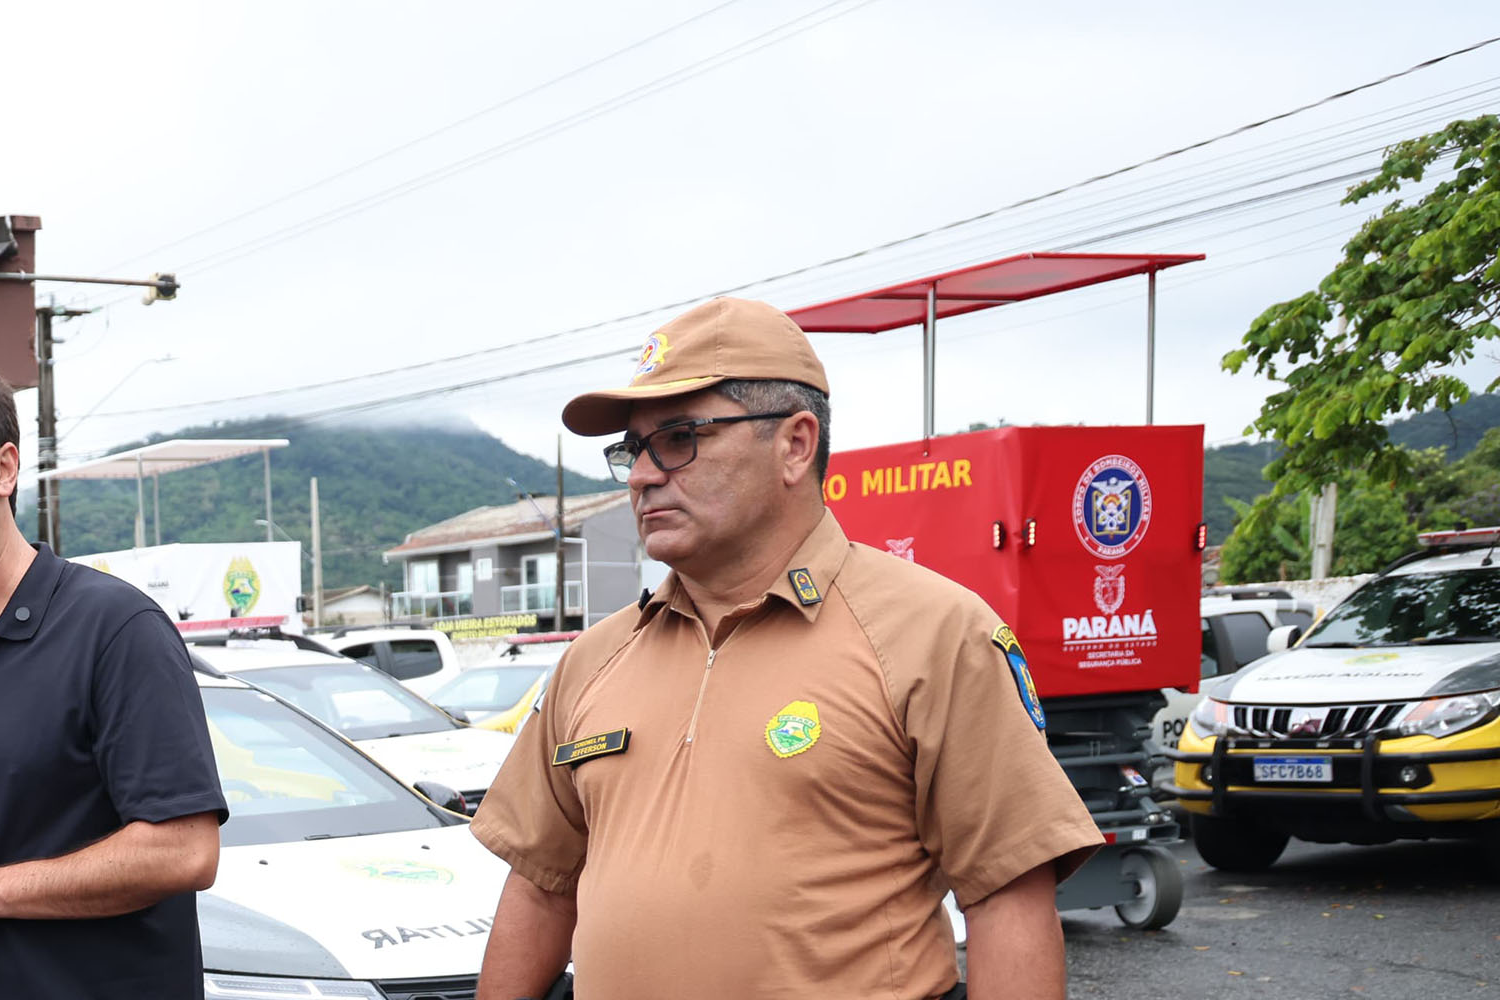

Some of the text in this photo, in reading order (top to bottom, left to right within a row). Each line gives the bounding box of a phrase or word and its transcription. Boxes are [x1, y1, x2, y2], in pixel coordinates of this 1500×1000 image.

[861, 459, 973, 497] MILITAR
[1062, 608, 1157, 640] PARANÁ
[570, 742, 608, 758] JEFFERSON
[1261, 765, 1323, 779] SFC7B68
